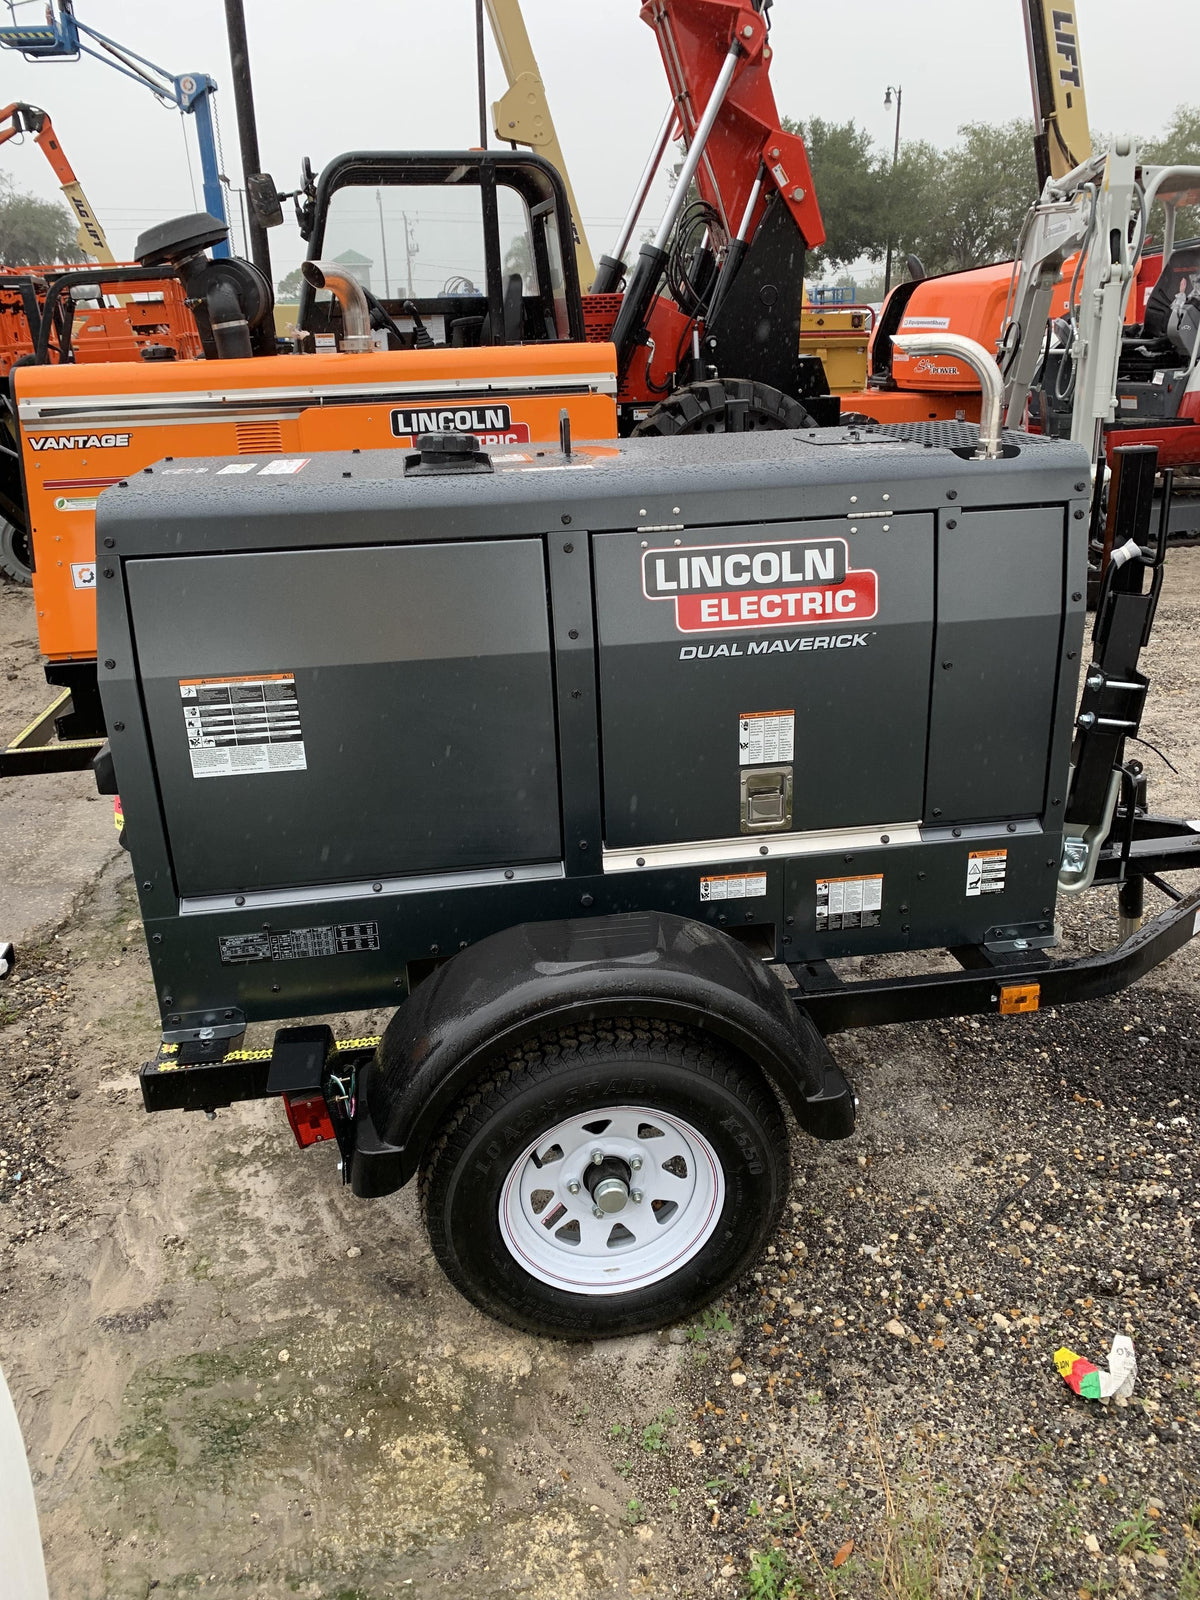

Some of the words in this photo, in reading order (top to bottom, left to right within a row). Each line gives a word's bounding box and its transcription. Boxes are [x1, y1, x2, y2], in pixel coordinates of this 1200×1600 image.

[1052, 9, 1081, 88] LIFT
[71, 196, 90, 218] JLG
[84, 222, 104, 249] LIFT
[397, 409, 504, 433] LINCOLN
[28, 433, 130, 451] VANTAGE
[655, 548, 835, 591] LINCOLN
[700, 589, 857, 623] ELECTRIC
[679, 643, 743, 660] DUAL
[747, 633, 870, 655] MAVERICK
